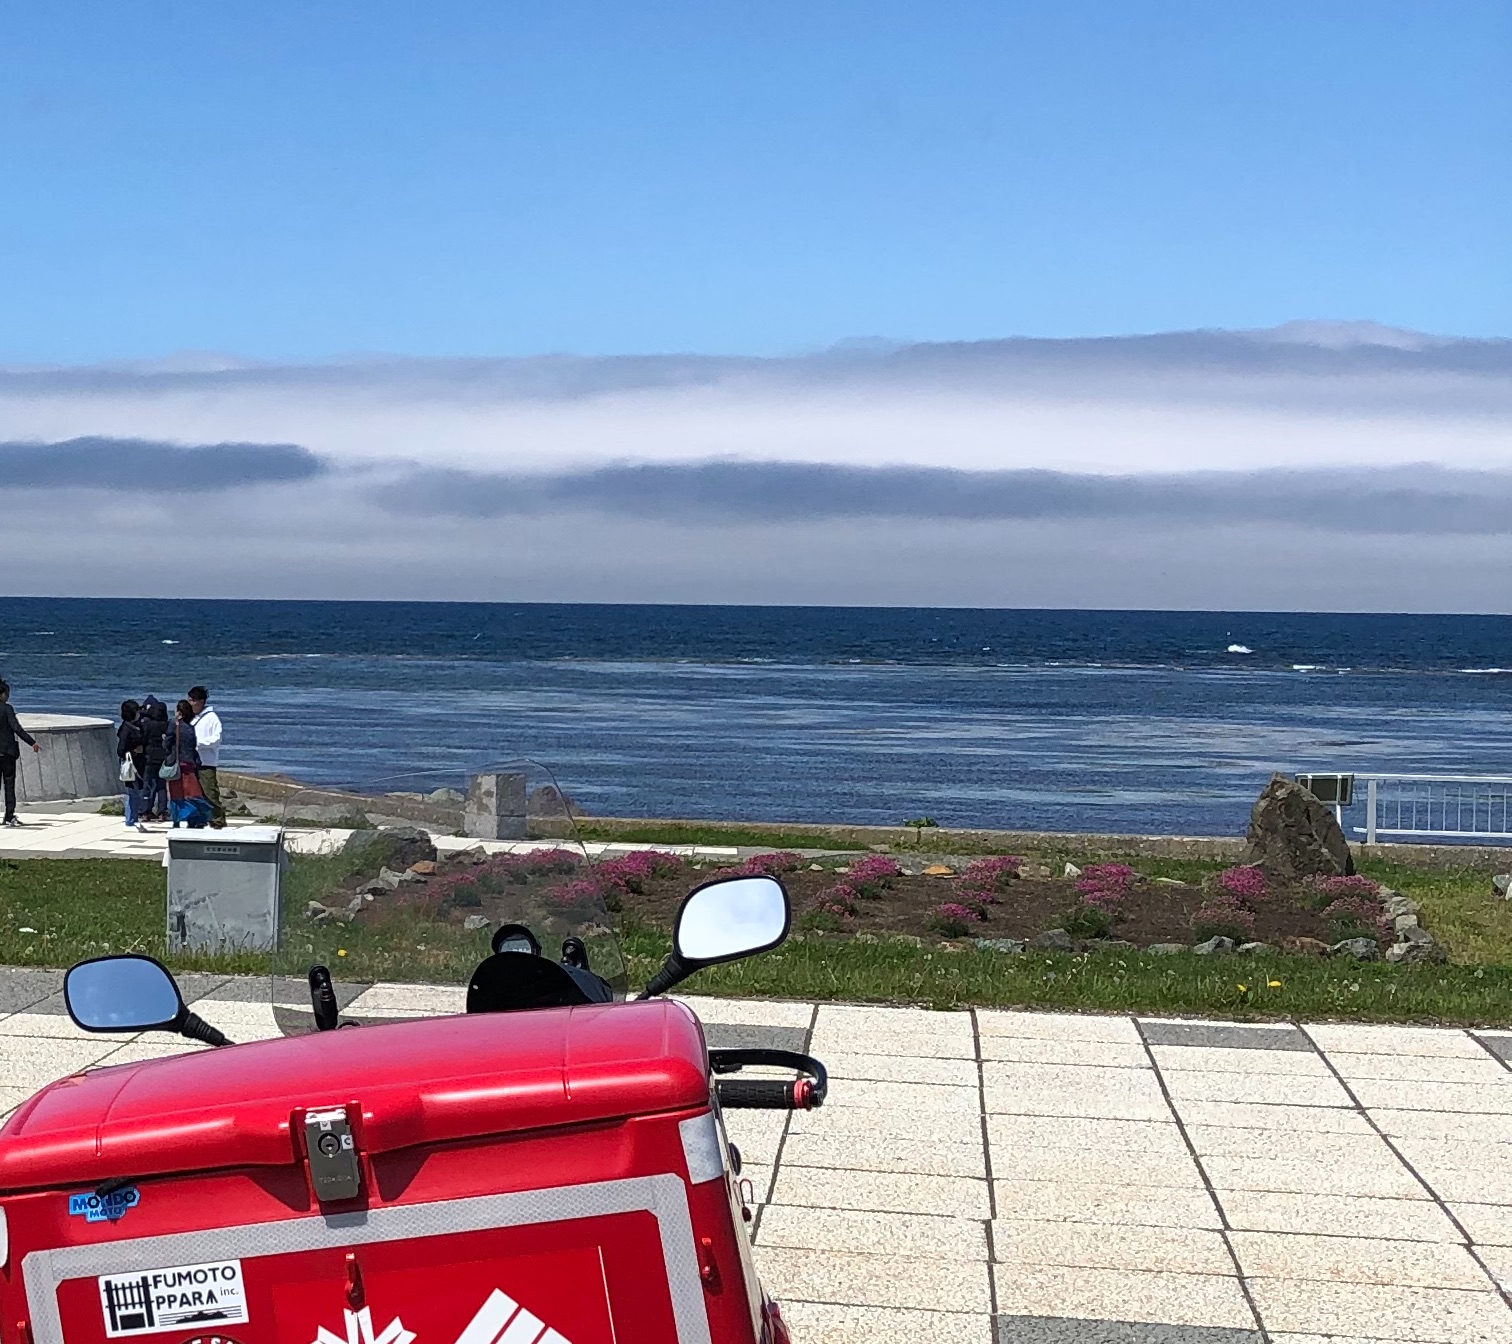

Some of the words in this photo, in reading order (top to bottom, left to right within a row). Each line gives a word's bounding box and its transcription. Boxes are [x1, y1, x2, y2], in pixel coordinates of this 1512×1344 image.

[89, 1206, 123, 1218] MOTO
[152, 1266, 237, 1290] FUMOTO
[155, 1289, 219, 1310] PPARA
[219, 1287, 240, 1297] inc.
